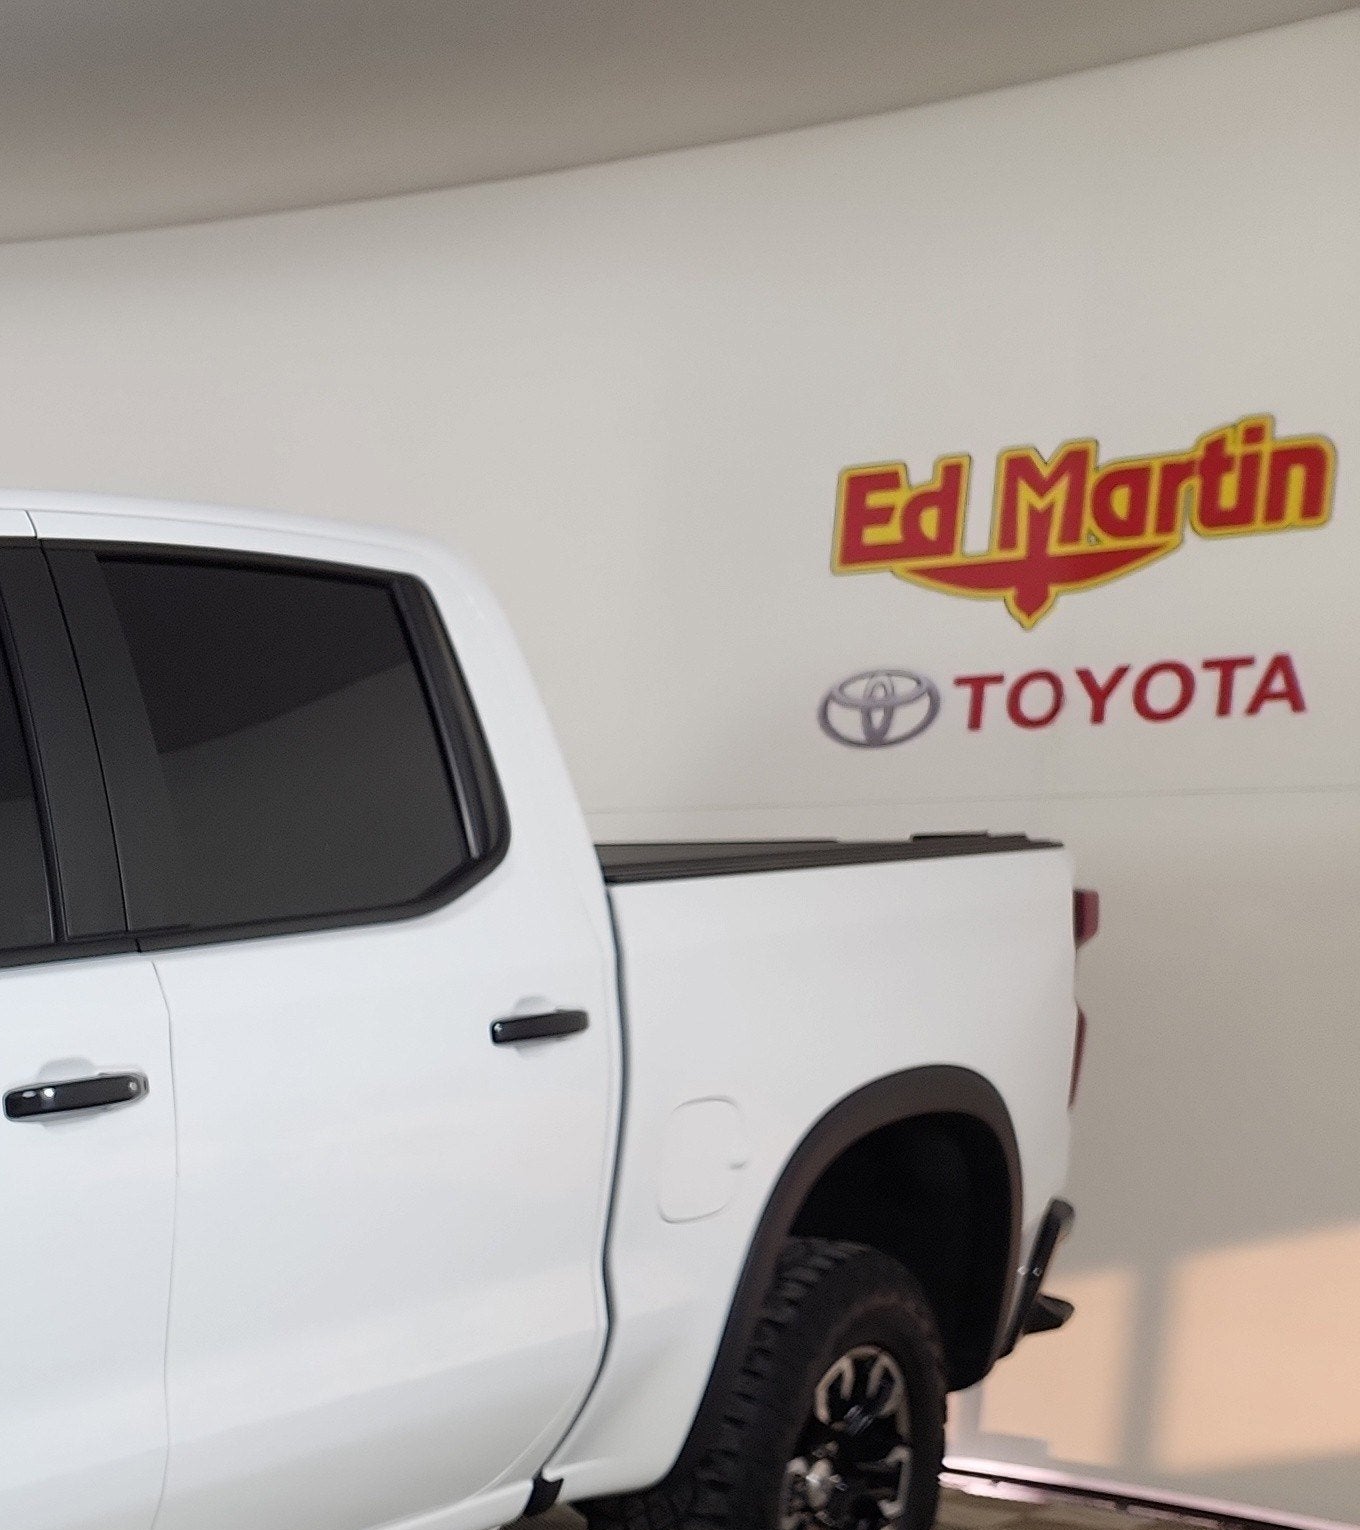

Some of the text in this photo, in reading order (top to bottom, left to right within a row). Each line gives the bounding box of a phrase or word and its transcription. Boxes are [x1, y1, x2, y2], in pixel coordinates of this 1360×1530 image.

[835, 417, 1333, 571] Ed Martin
[953, 652, 1307, 732] TOYOTA
